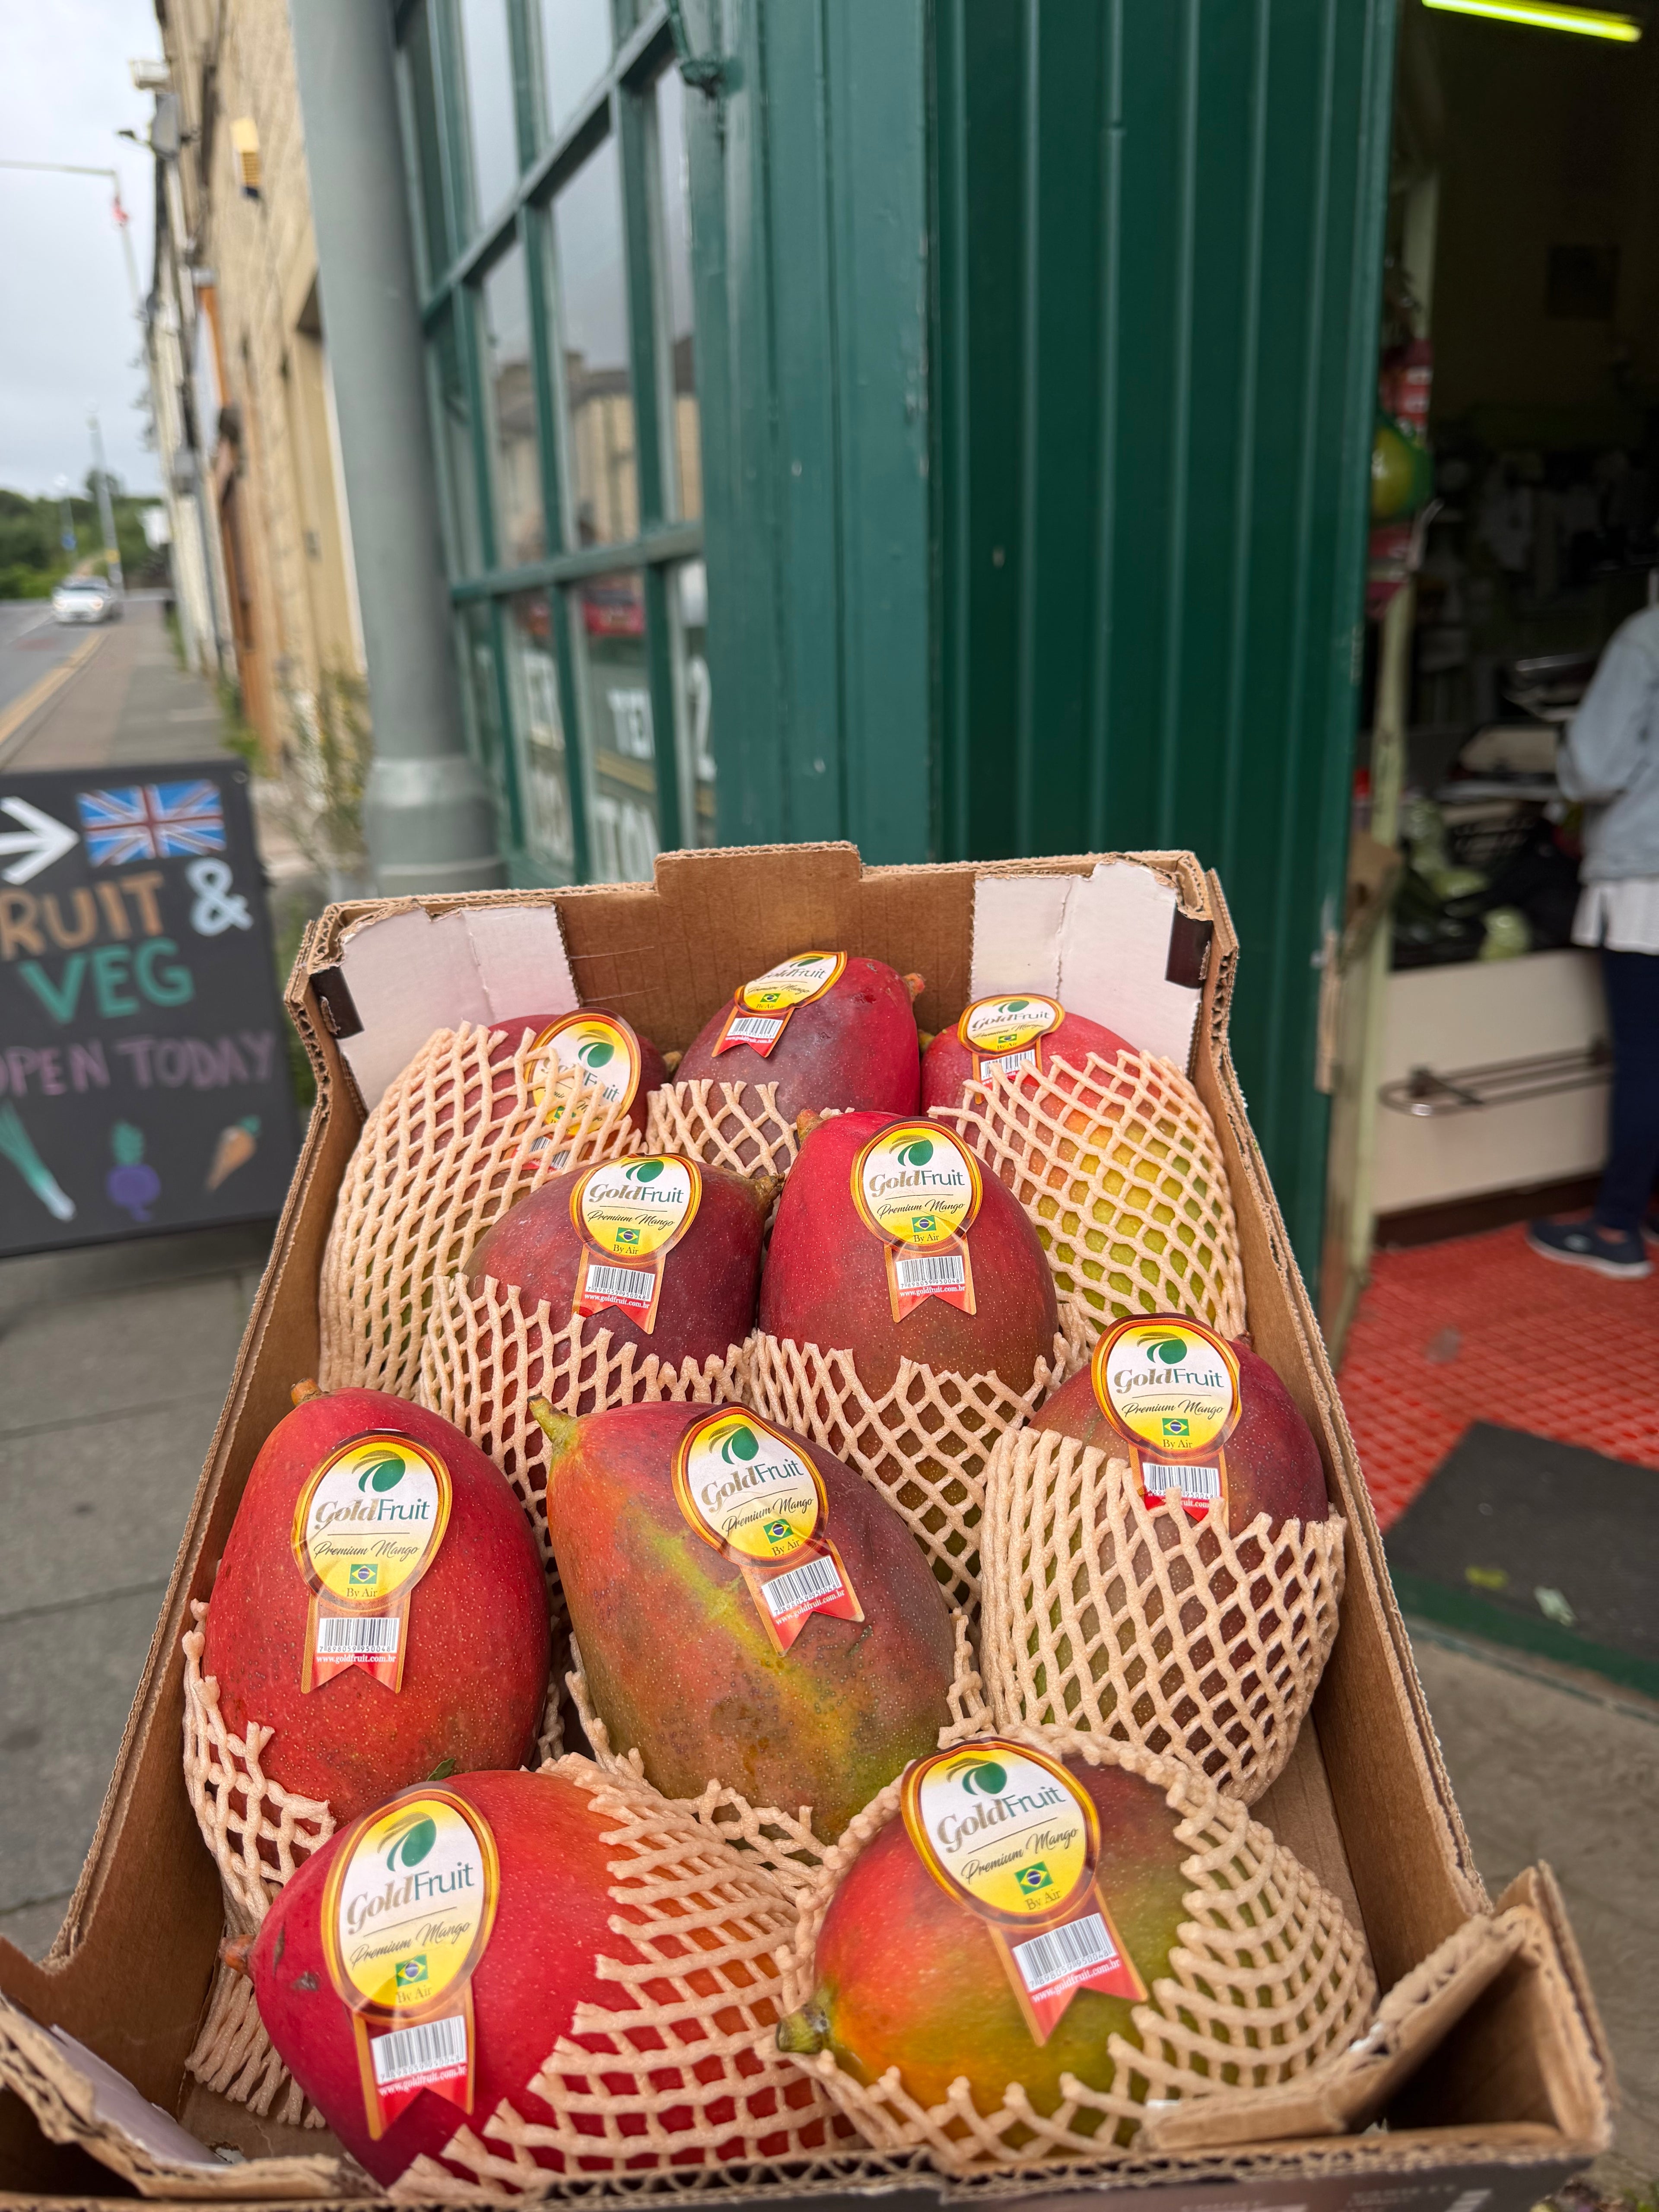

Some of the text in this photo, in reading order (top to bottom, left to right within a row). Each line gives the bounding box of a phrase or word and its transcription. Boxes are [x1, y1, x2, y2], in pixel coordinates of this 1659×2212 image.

[185, 857, 254, 937] &
[18, 936, 195, 1025] VEG
[117, 1032, 276, 1091] TODAY
[589, 1184, 684, 1204] GoldFruit
[869, 1169, 965, 1198] GoldFruit
[588, 1210, 675, 1230] Premium Mango
[877, 1199, 965, 1220] Premium Mango
[613, 1244, 639, 1255] By Air
[914, 1234, 925, 1244] By
[1114, 1368, 1225, 1394] GoldFruit
[1122, 1399, 1224, 1420] Premium Mango
[1163, 1439, 1193, 1449] By Air
[700, 1459, 804, 1513] GoldFruit
[315, 1498, 430, 1530] GoldFruit
[721, 1497, 814, 1535] Premium Mango
[313, 1540, 419, 1562] Premium Mango
[771, 1539, 800, 1557] By Air
[346, 1588, 378, 1599] By Air
[936, 1786, 1067, 1853] GoldFruit
[960, 1826, 1079, 1885] Premium Mango
[347, 1862, 475, 1936] GoldFruit
[1024, 1889, 1061, 1911] By Air
[350, 1920, 473, 1971] Premium Mango
[414, 1987, 432, 2000] Air
